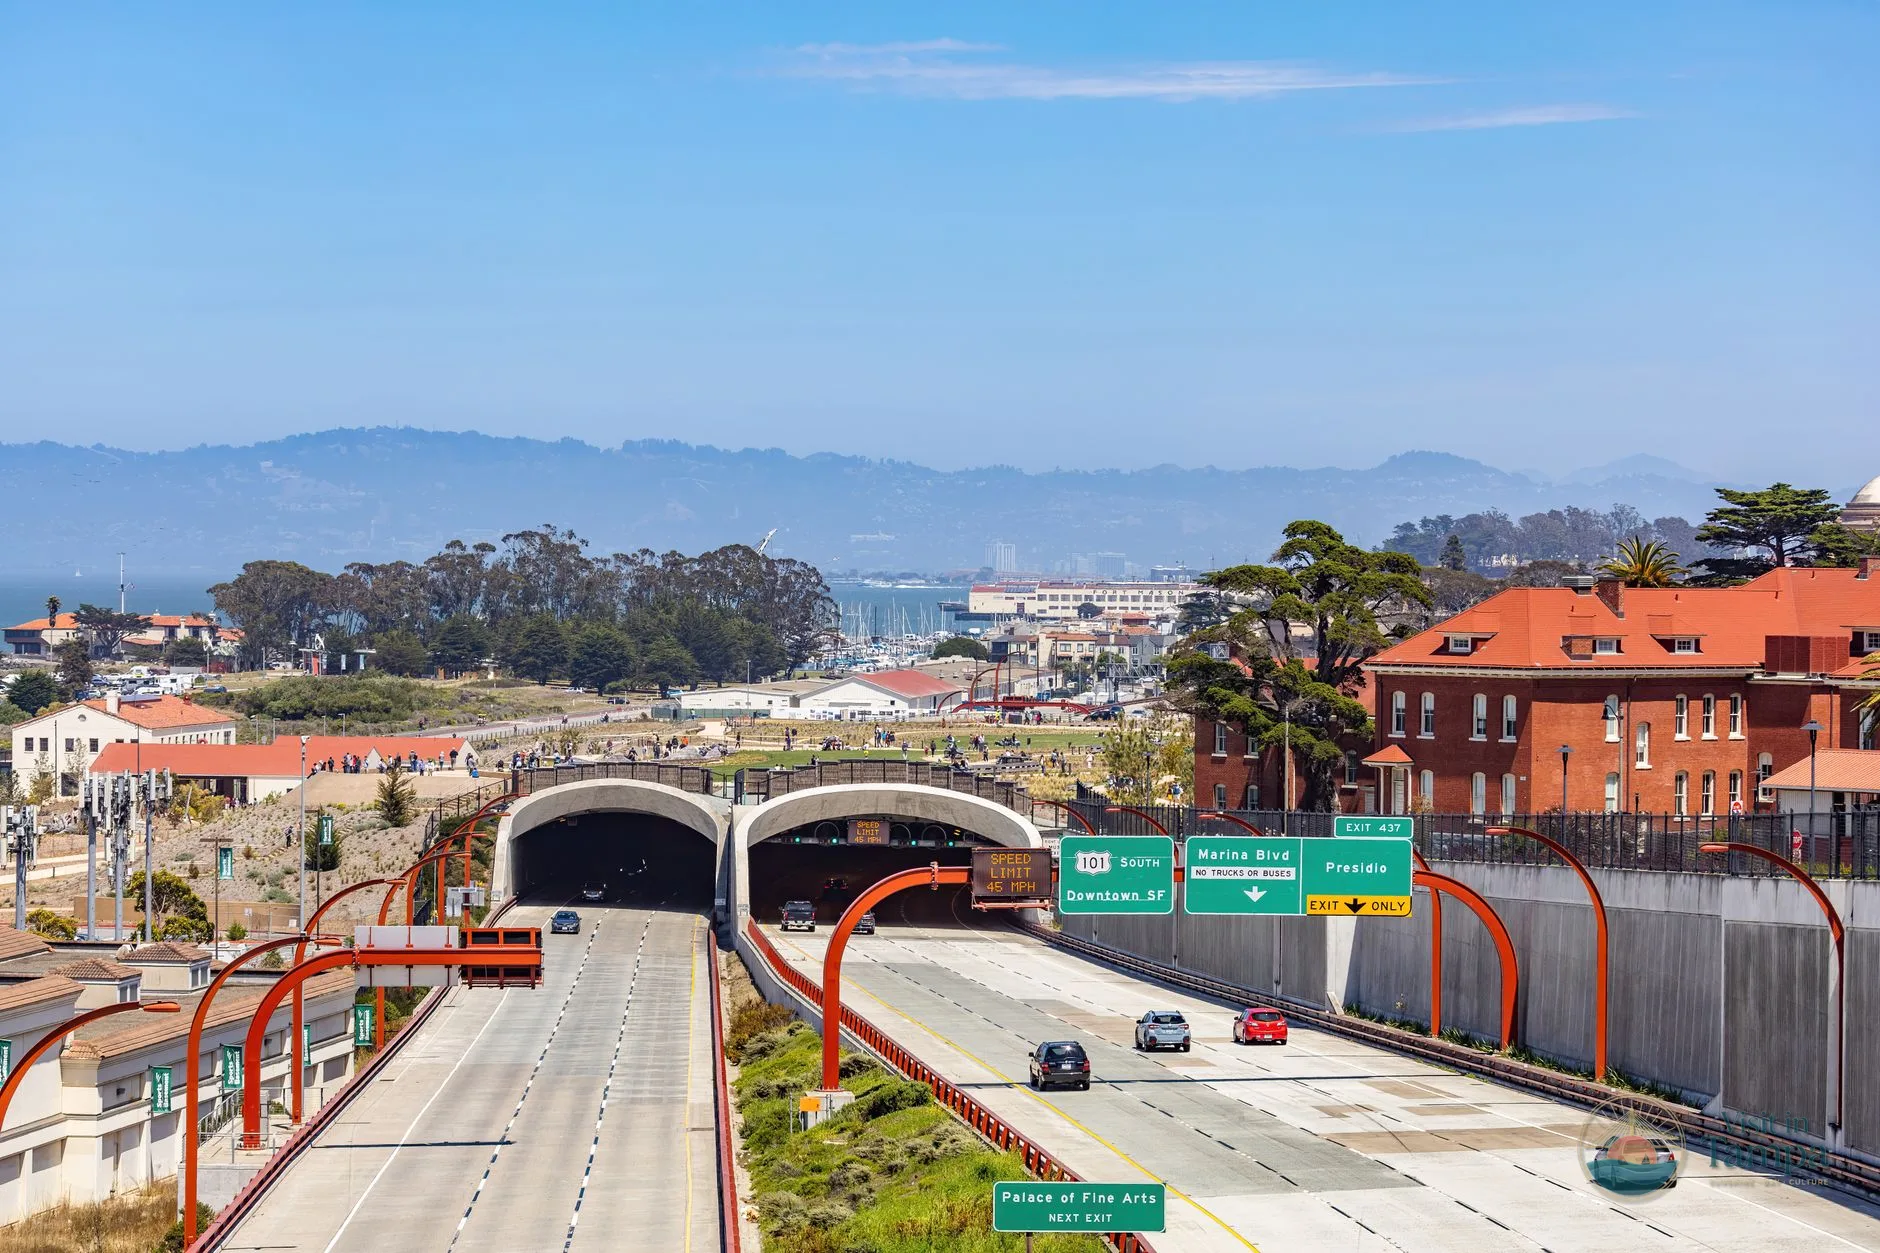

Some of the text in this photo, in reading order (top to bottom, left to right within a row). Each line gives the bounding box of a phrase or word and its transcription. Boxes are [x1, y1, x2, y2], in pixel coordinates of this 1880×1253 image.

[1346, 823, 1401, 833] EXIT 437
[990, 853, 1032, 865] SPEED
[1198, 848, 1290, 861] Marina Blvd
[1083, 857, 1160, 869] 101 SOUTH
[1326, 862, 1387, 873] Presidio
[990, 867, 1032, 879] LIMIT
[986, 881, 1036, 892] 45 MPH
[1066, 890, 1166, 901] Downtown SF
[1310, 900, 1405, 911] EXIT ONLY
[1002, 1191, 1156, 1204] Palace of Fine Arts
[1048, 1213, 1113, 1223] NEXT EXIT
